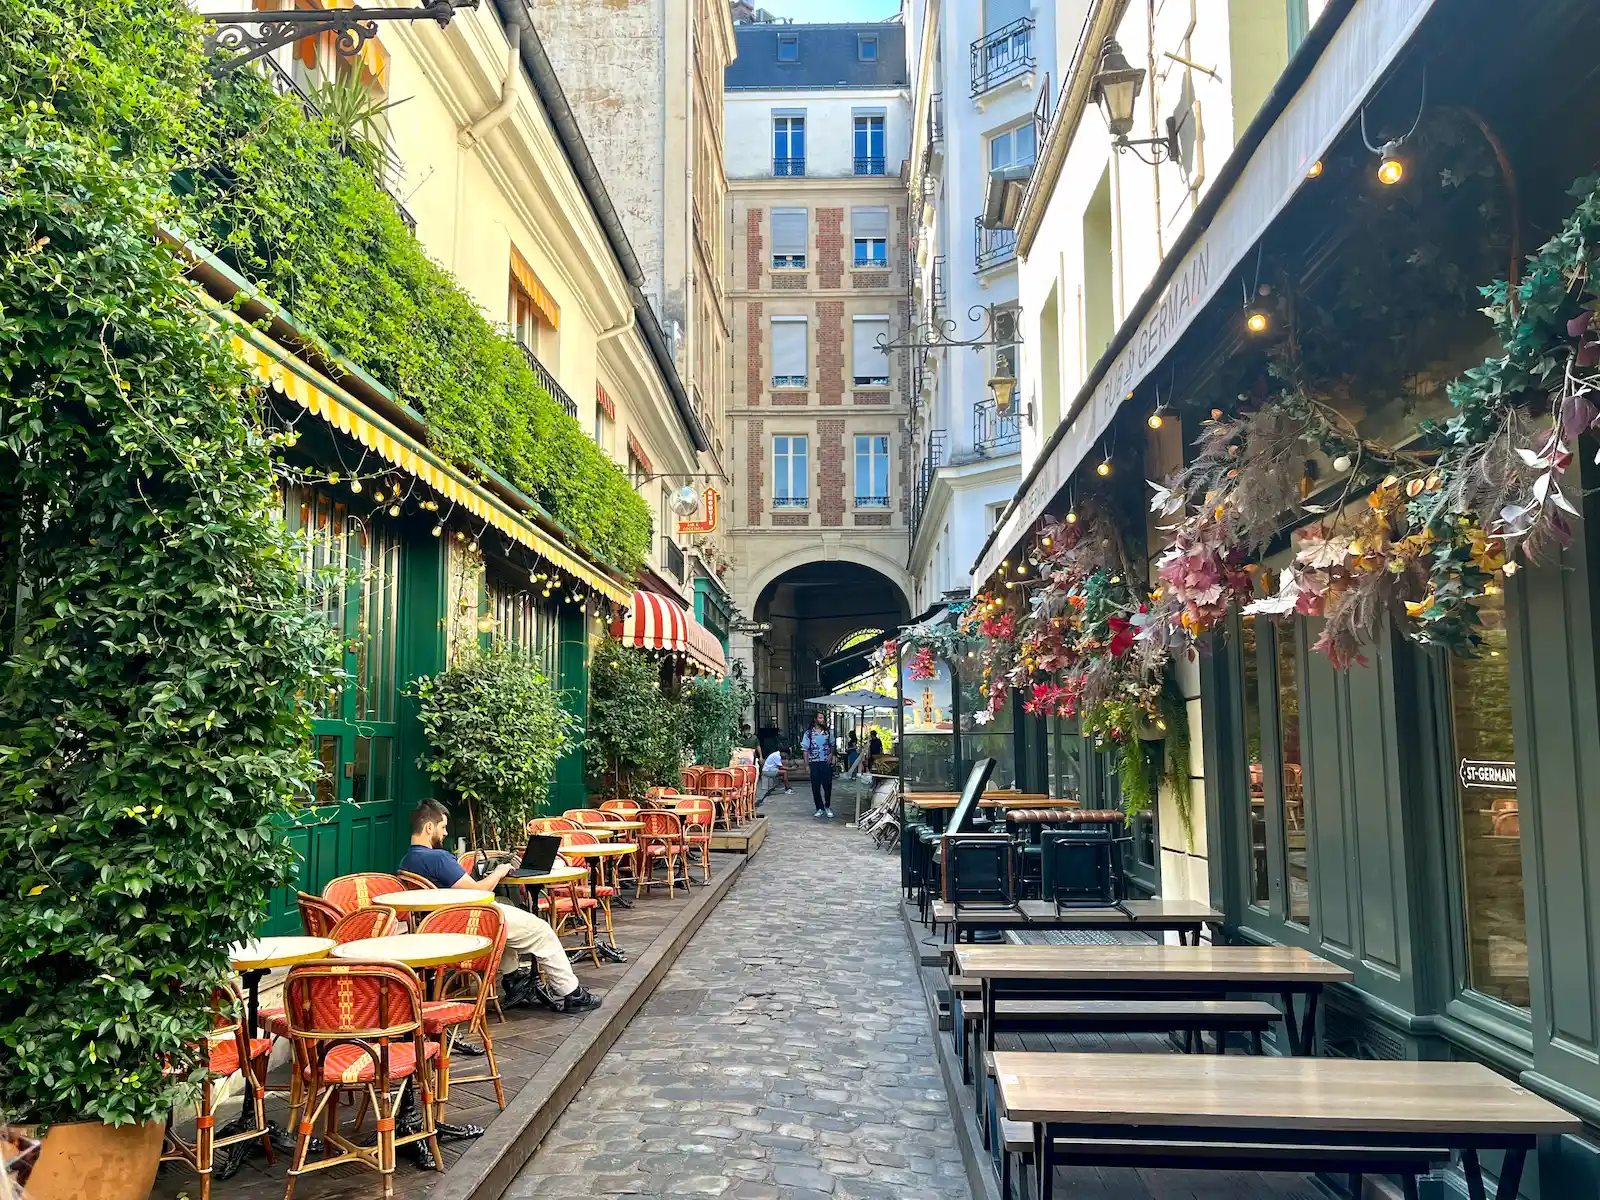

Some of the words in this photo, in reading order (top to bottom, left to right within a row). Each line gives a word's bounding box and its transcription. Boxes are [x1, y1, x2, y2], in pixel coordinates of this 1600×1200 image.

[1104, 361, 1124, 417] PUB
[1138, 242, 1210, 369] GERMAIN
[1466, 766, 1517, 783] ST-GERMAIN
